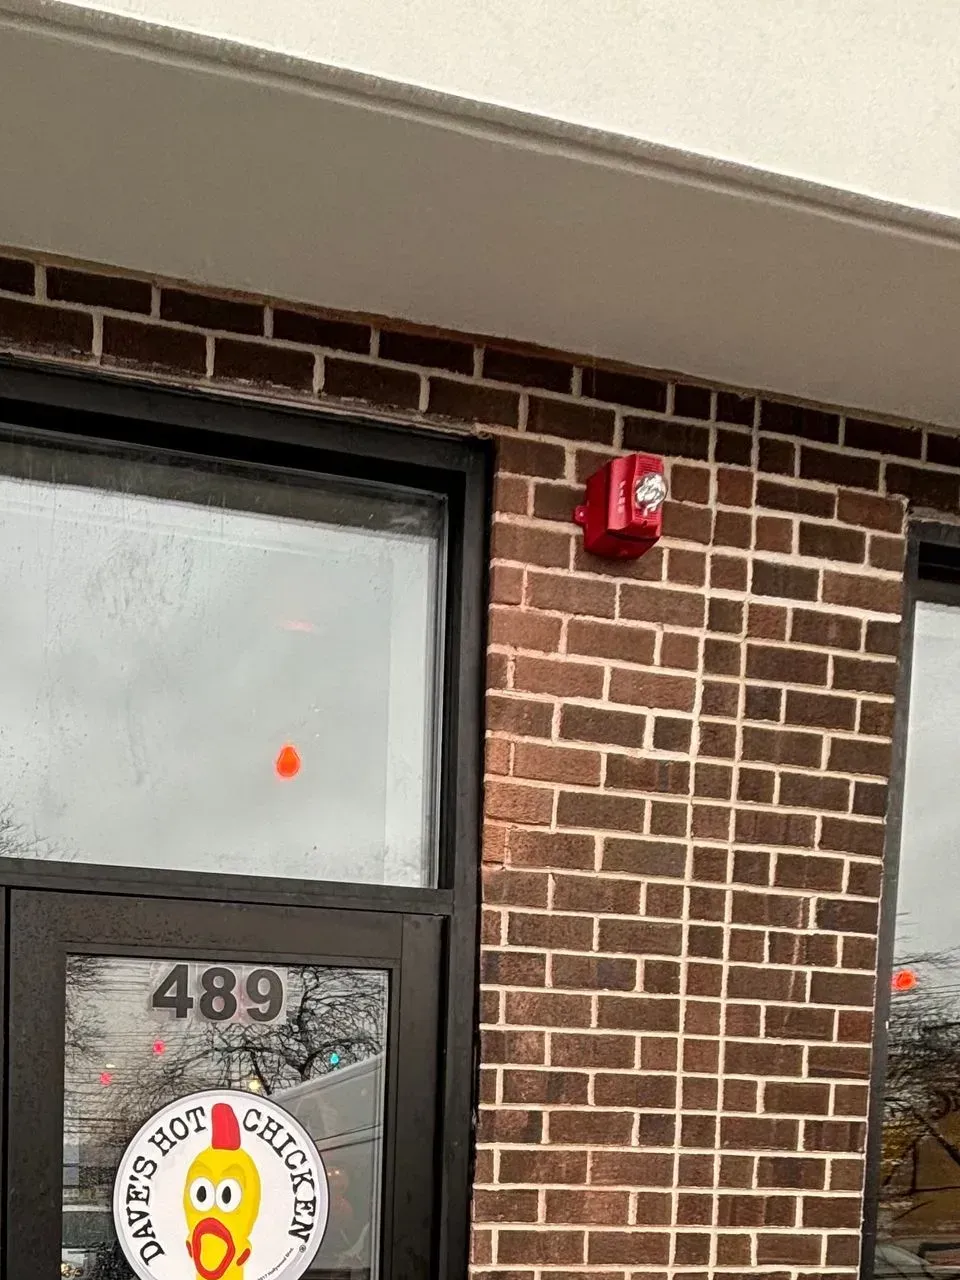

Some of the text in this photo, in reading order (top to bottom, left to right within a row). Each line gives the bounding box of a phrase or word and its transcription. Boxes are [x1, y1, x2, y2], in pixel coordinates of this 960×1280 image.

[152, 964, 284, 1022] 489
[126, 1106, 317, 1266] DAVE'S HOT CHICKEN
